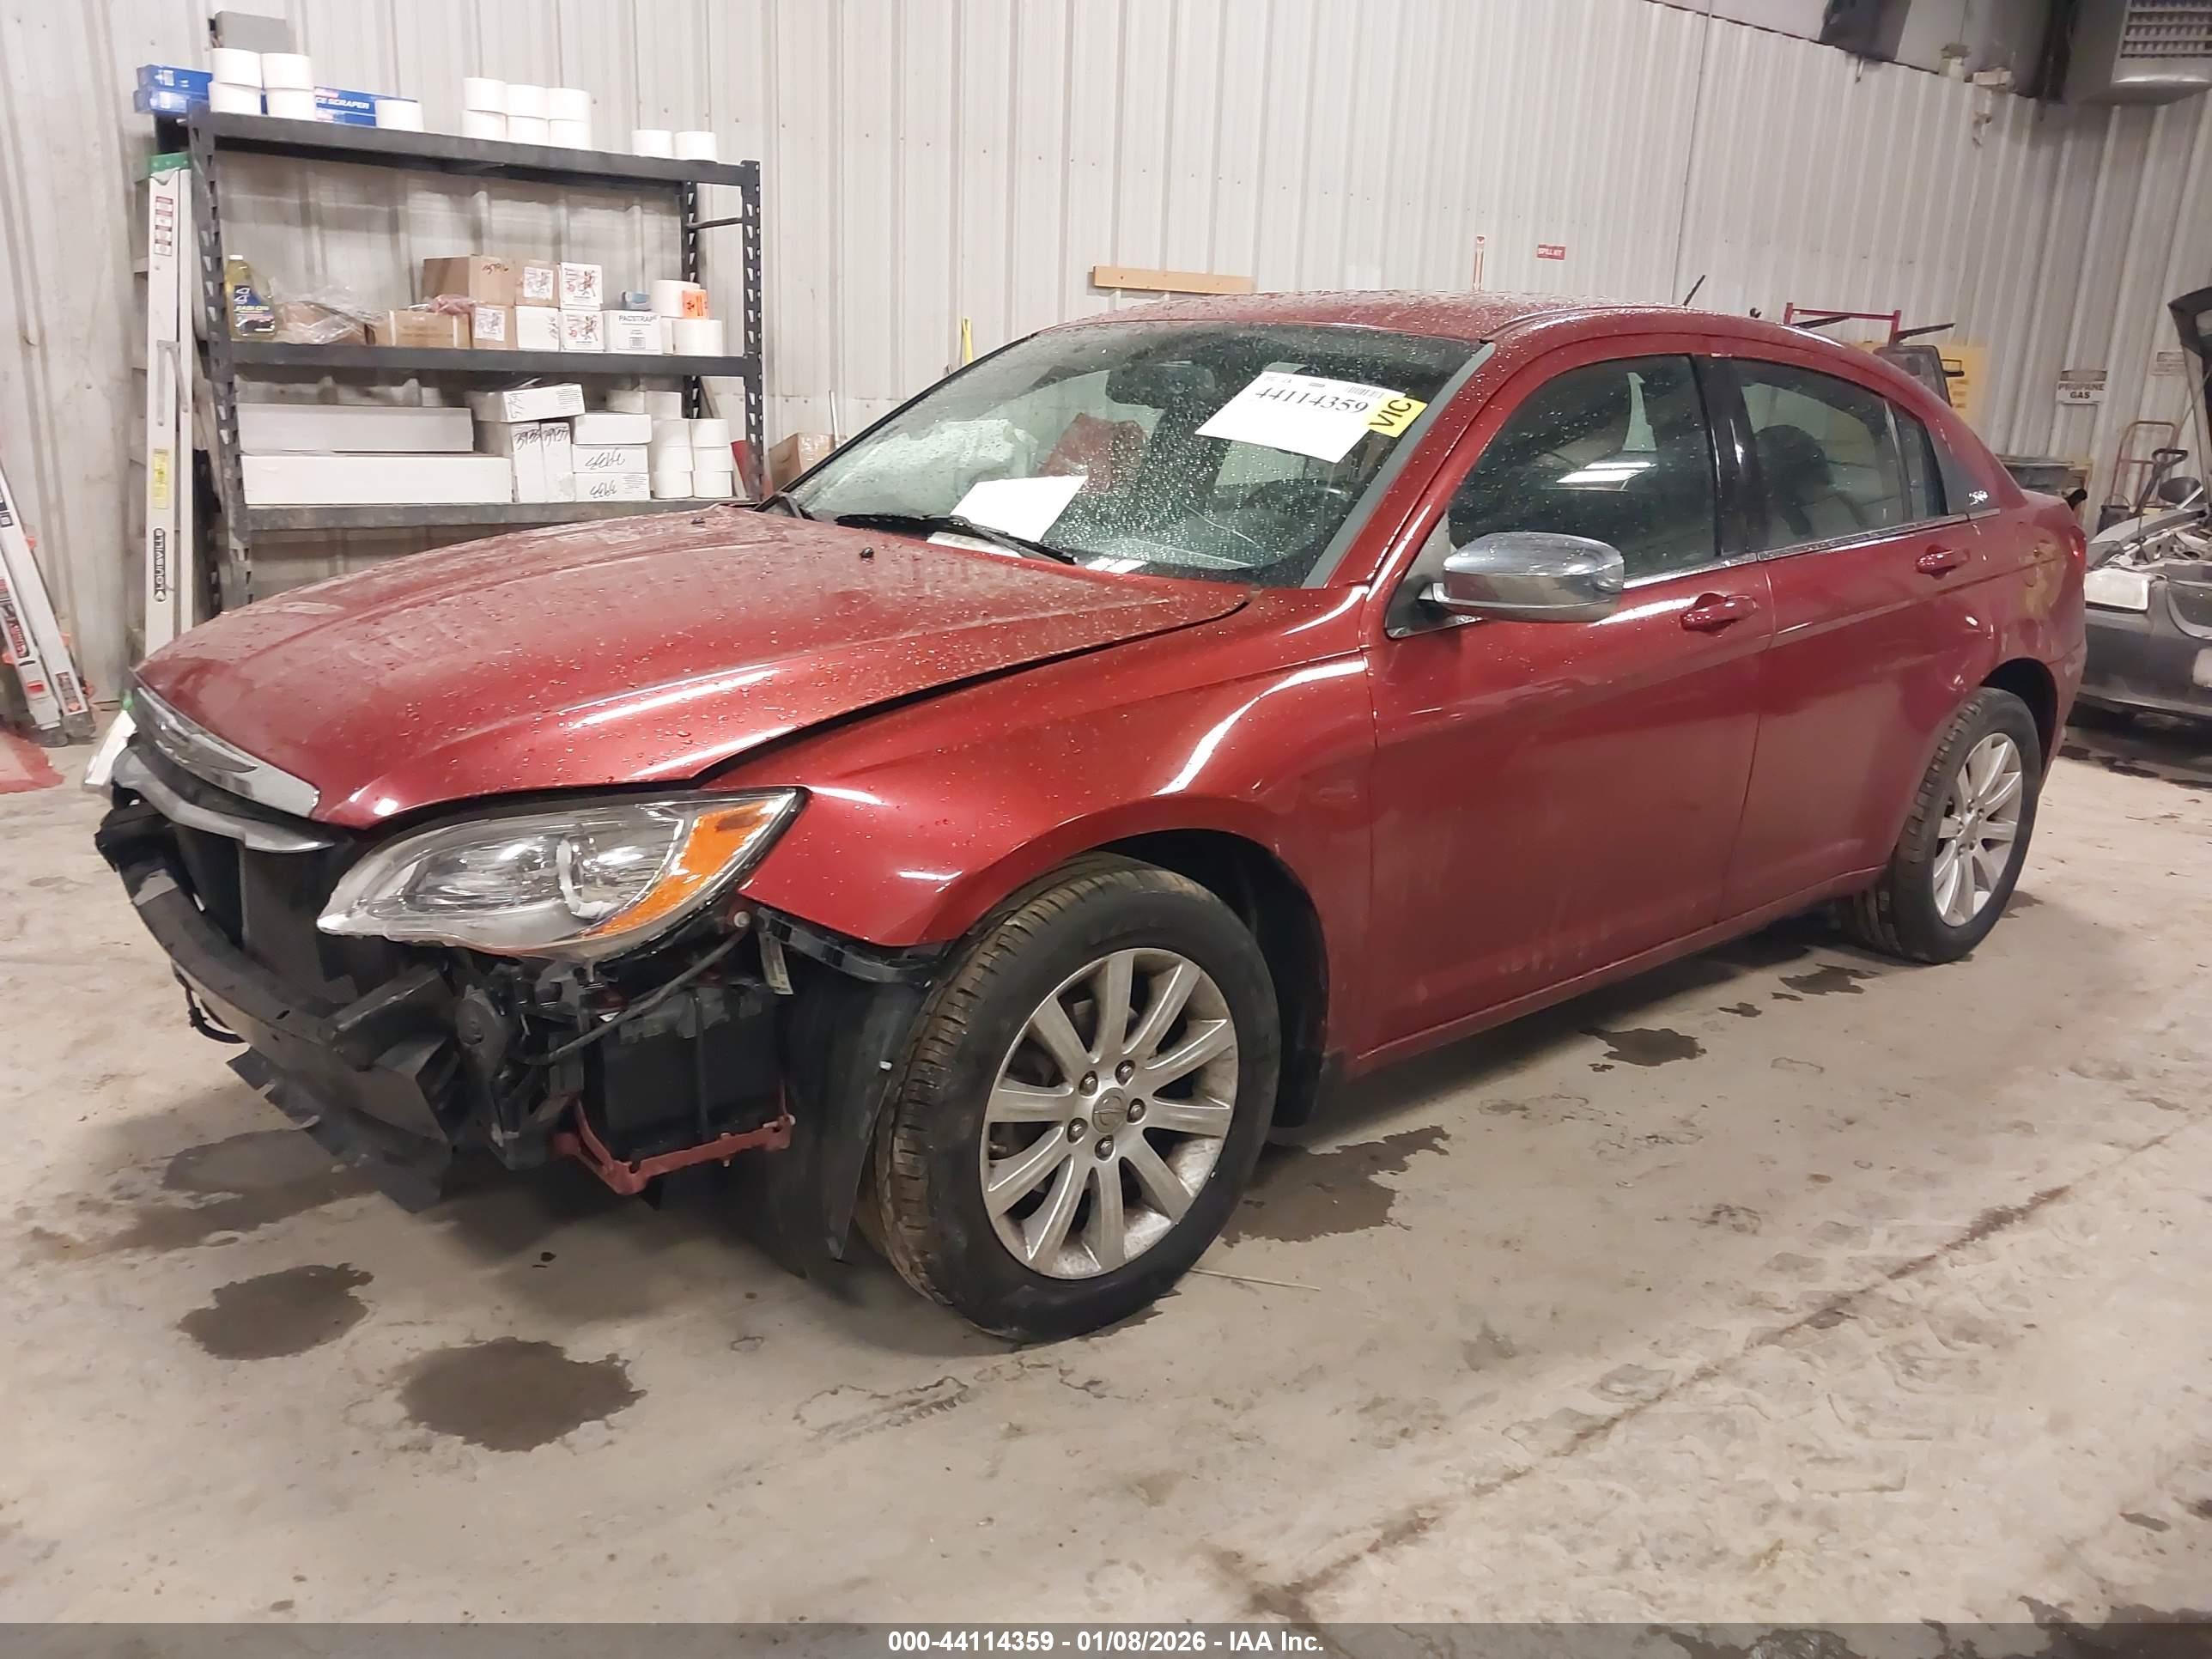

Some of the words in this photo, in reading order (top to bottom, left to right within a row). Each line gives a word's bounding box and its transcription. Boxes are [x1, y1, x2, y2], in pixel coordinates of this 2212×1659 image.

[328, 98, 369, 110] SCRAPER
[1255, 387, 1369, 413] 44114359
[2069, 391, 2091, 399] GAS
[1368, 399, 1412, 427] VIC
